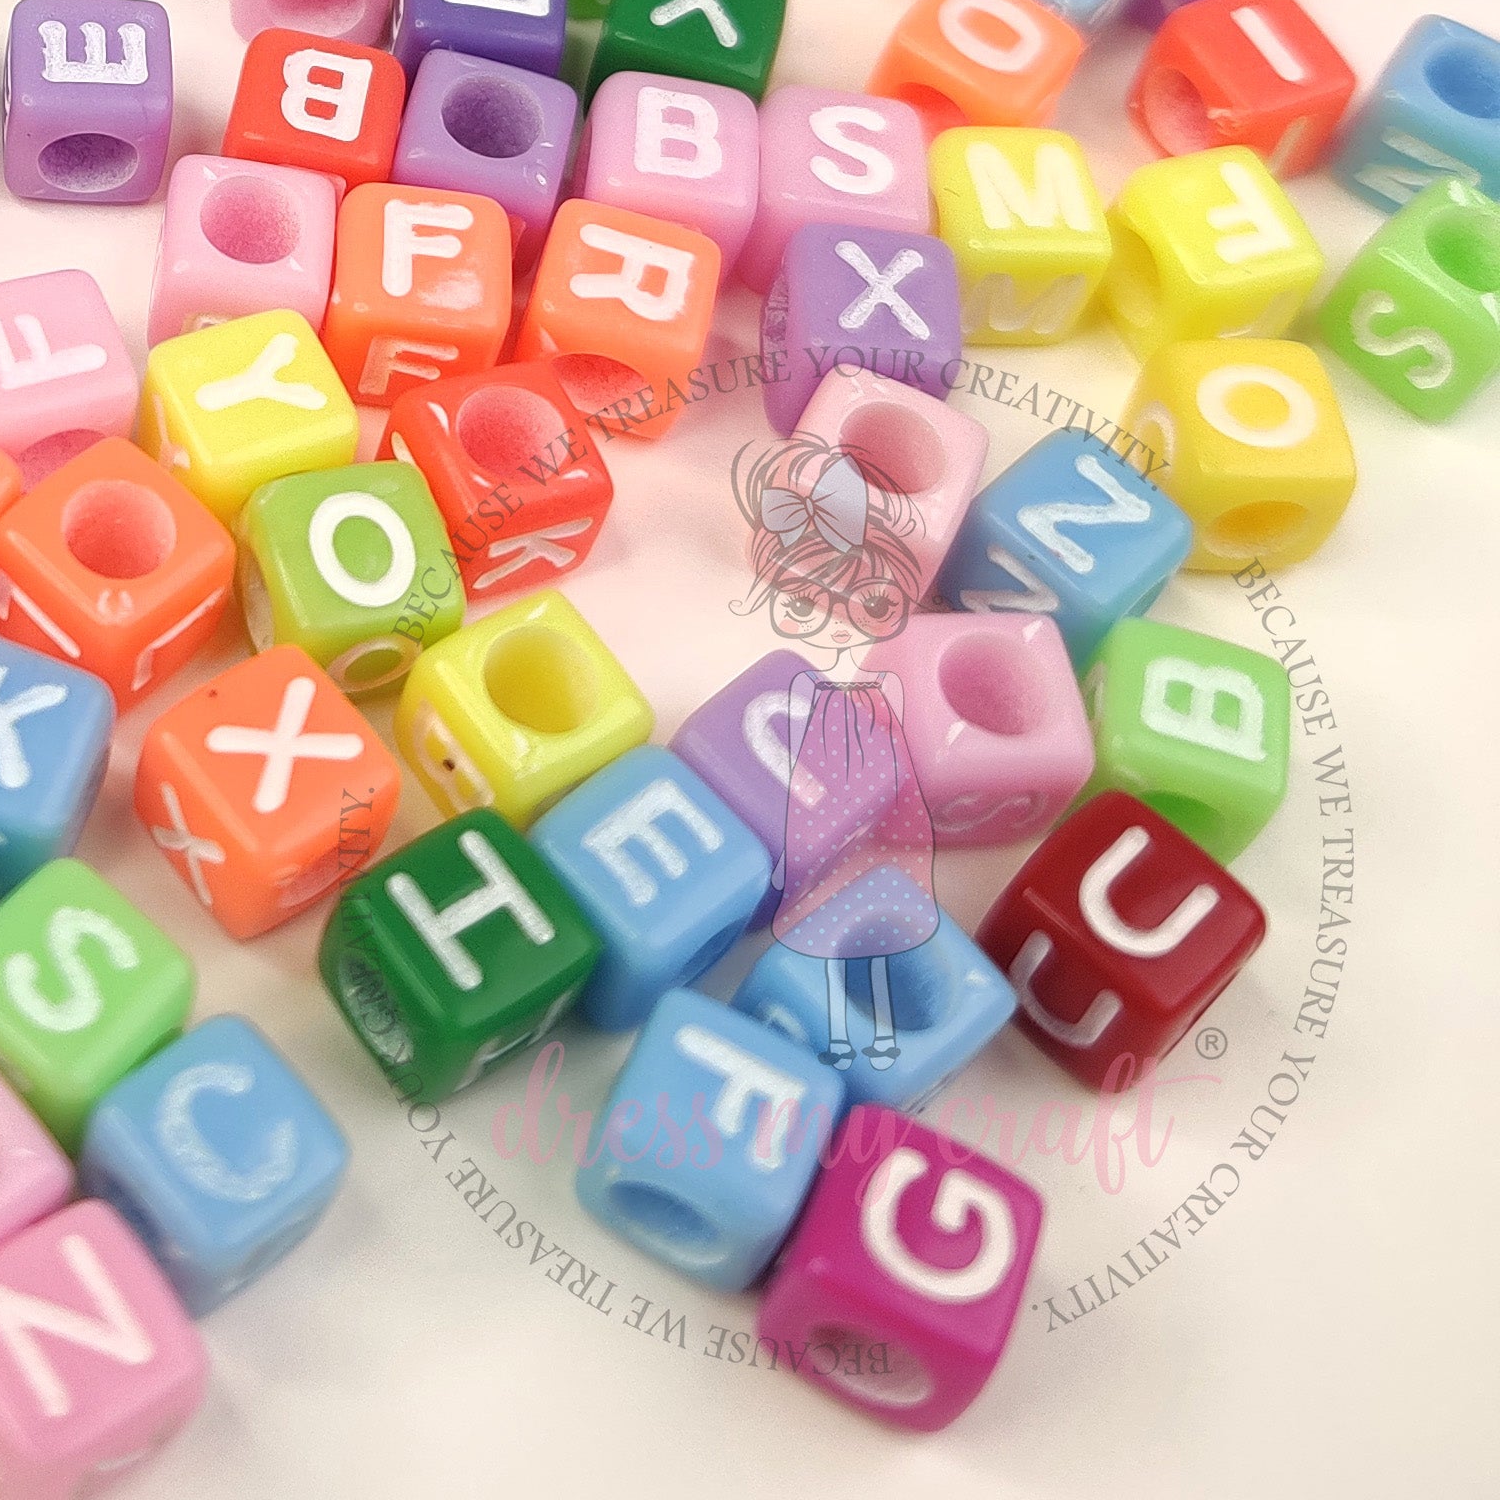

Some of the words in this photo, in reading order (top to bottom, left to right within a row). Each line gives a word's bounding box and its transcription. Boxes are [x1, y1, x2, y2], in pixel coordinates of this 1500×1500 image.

[37, 20, 148, 85] E
[280, 47, 373, 142] B
[1229, 5, 1306, 83] I
[633, 85, 724, 180] B
[806, 104, 895, 195] S
[964, 140, 1095, 232] M
[1205, 160, 1297, 265] F
[381, 198, 475, 297] F
[568, 222, 699, 322] R
[834, 240, 931, 341] X
[193, 332, 328, 412] Y
[1350, 289, 1456, 390] S
[1196, 363, 1317, 449] O
[308, 490, 416, 609] O
[471, 516, 594, 591] K
[205, 675, 366, 815] X
[1139, 655, 1268, 763] B
[151, 781, 226, 906] X
[579, 776, 725, 907] E
[1078, 824, 1221, 959] U
[383, 827, 557, 993] H
[3, 905, 141, 1034] S
[1009, 928, 1124, 1047] U
[155, 1061, 297, 1201] C
[674, 1024, 810, 1171] F
[860, 1146, 1018, 1304] G
